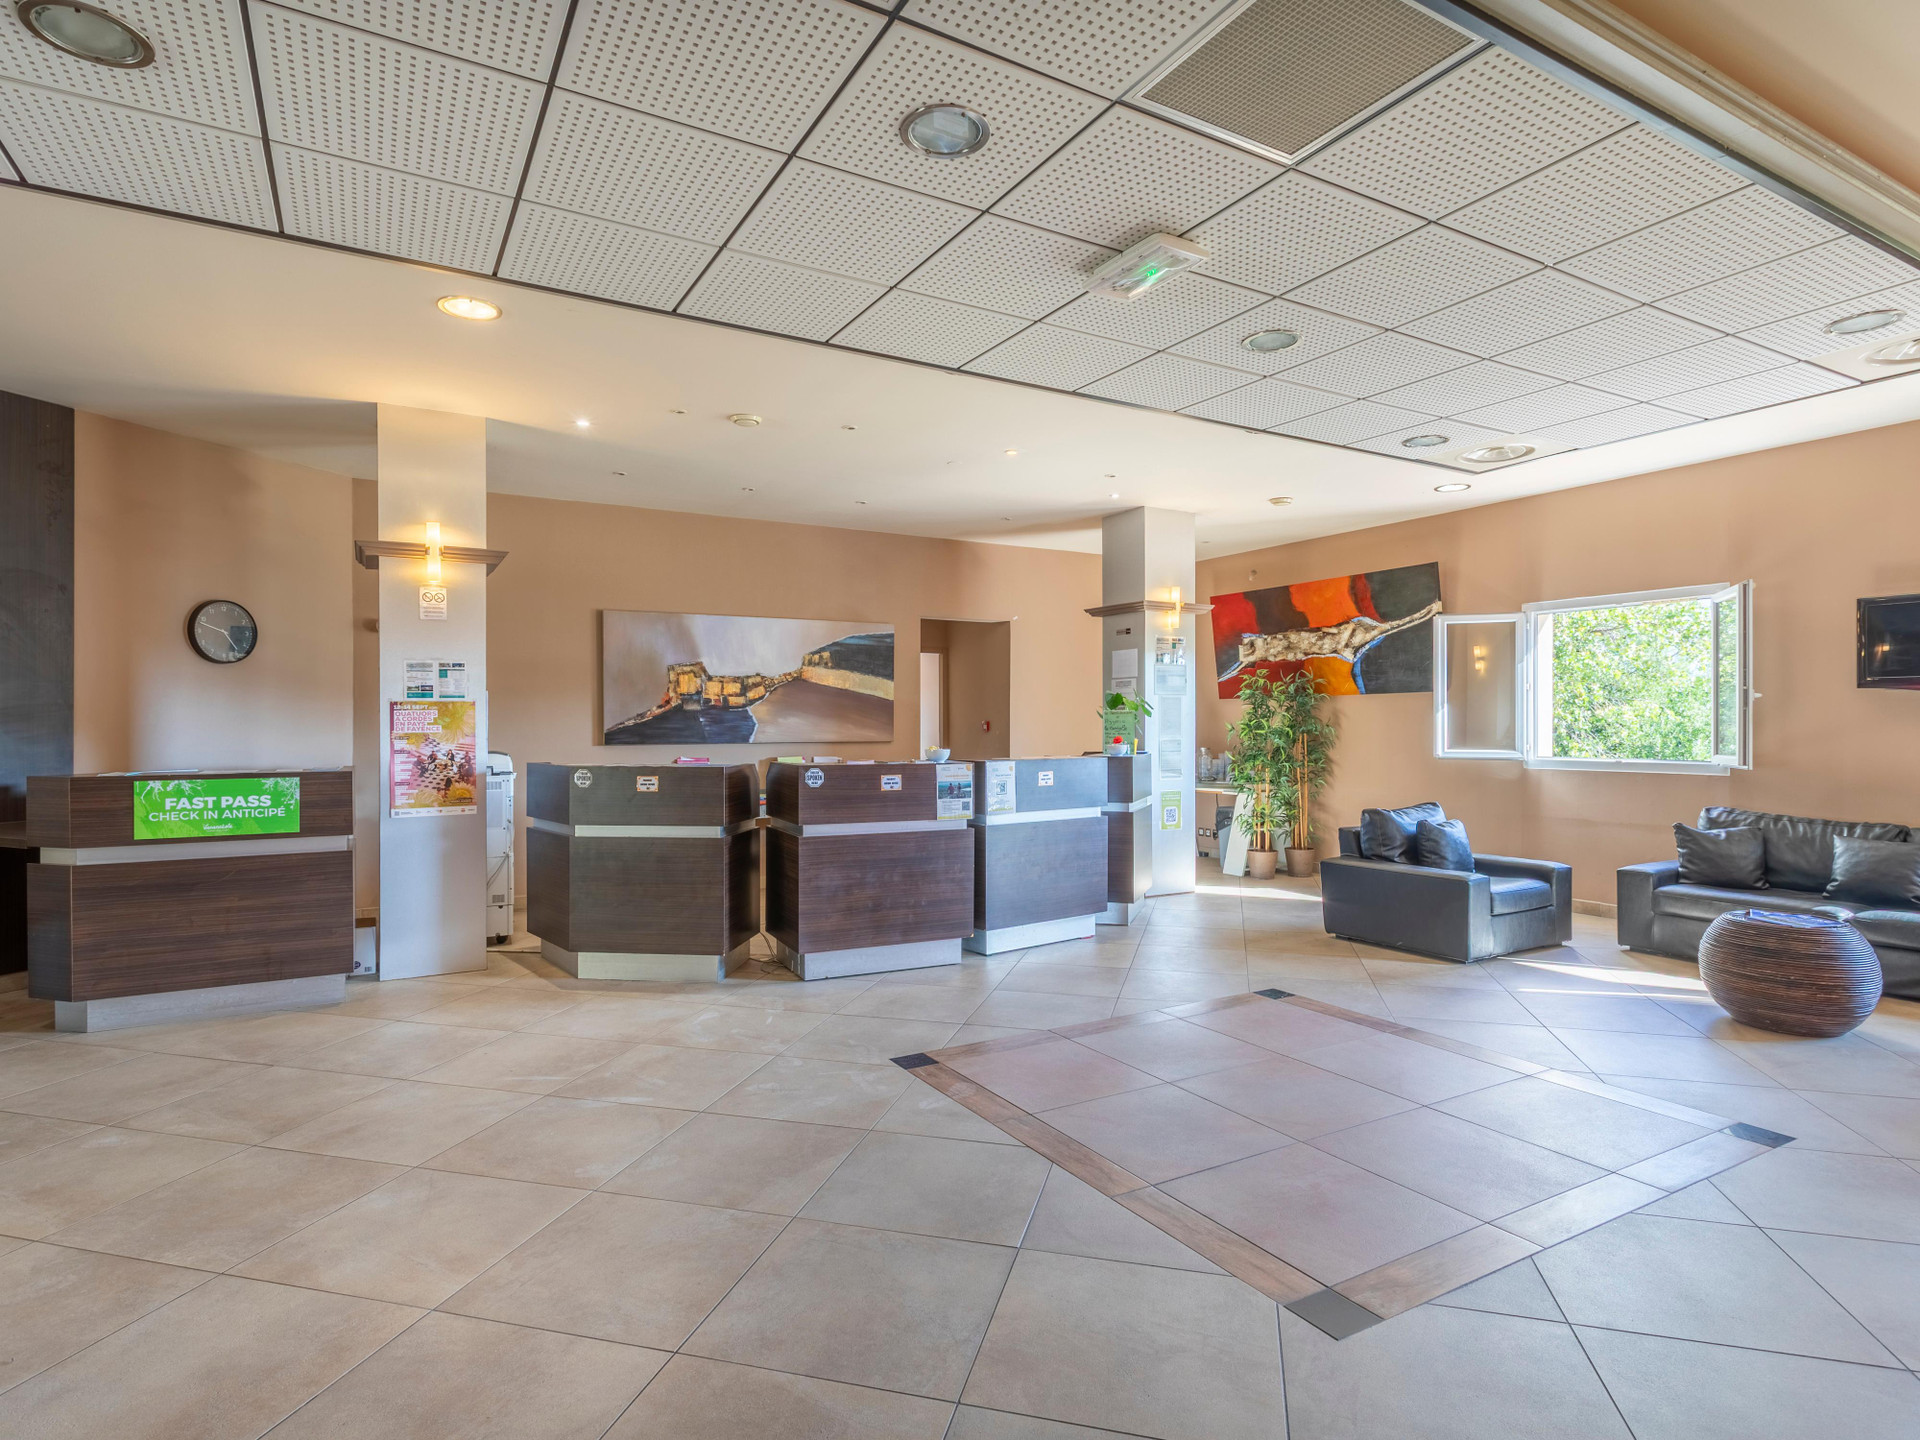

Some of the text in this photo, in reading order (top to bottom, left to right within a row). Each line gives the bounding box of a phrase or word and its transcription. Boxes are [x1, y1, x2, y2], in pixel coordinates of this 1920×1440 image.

[164, 795, 272, 810] FAST PASS
[148, 805, 286, 822] CHECK IN ANTICIPÉ
